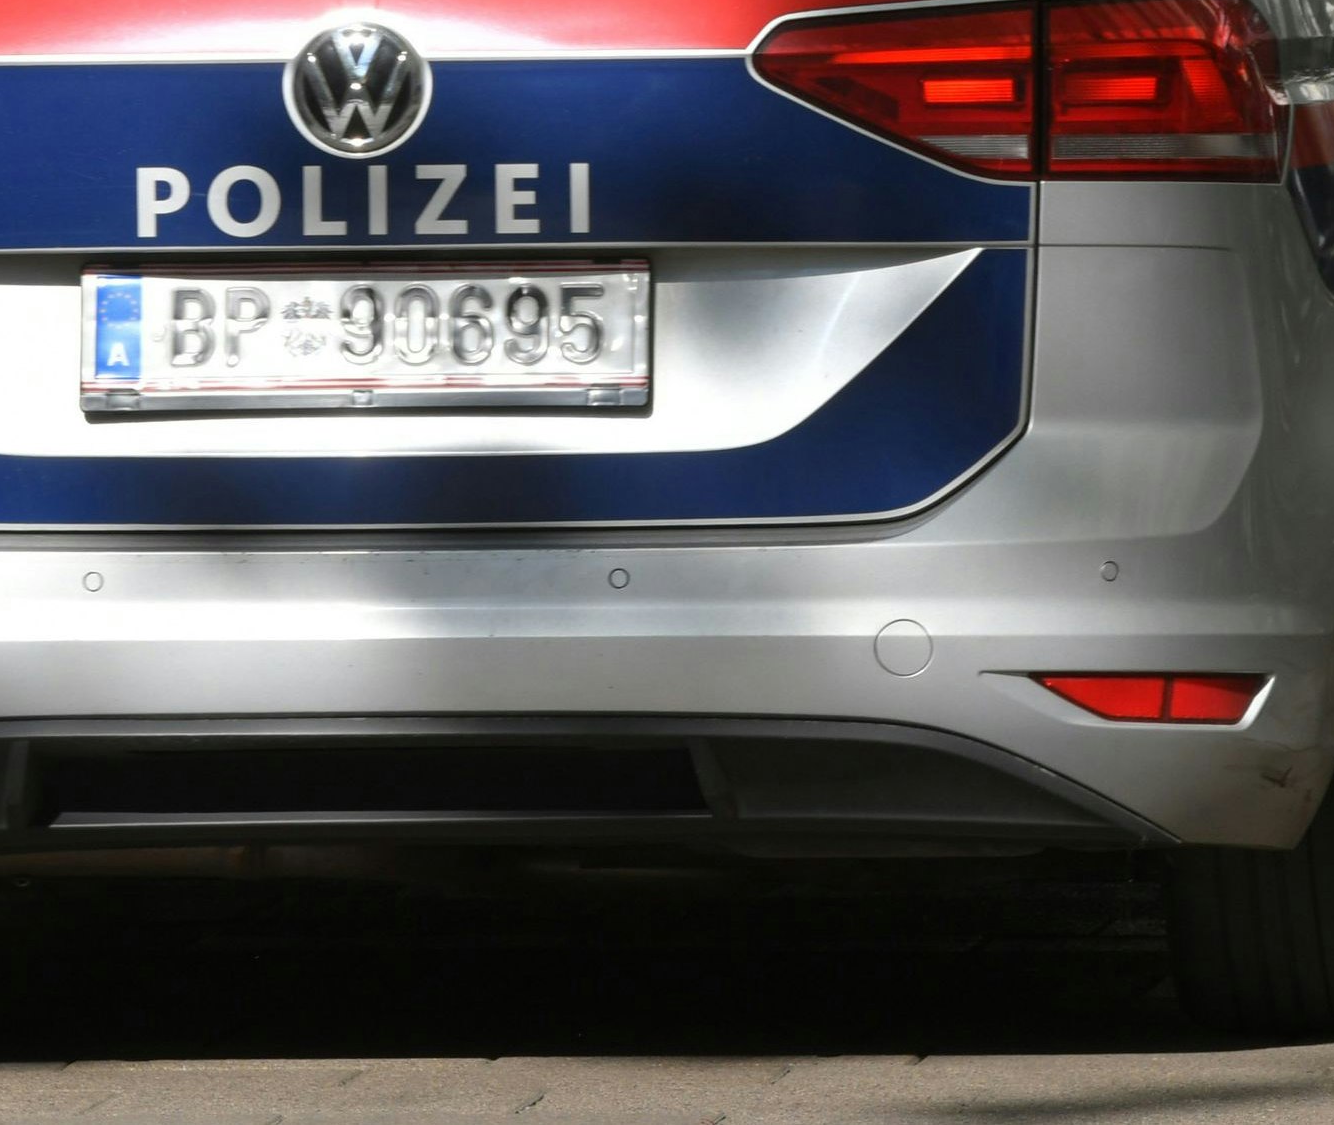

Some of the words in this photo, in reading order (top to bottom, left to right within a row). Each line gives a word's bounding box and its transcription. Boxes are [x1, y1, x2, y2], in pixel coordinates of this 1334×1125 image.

[136, 163, 590, 239] POLIZEI
[107, 343, 129, 367] A
[169, 285, 269, 369] BP
[339, 282, 605, 366] 90695
